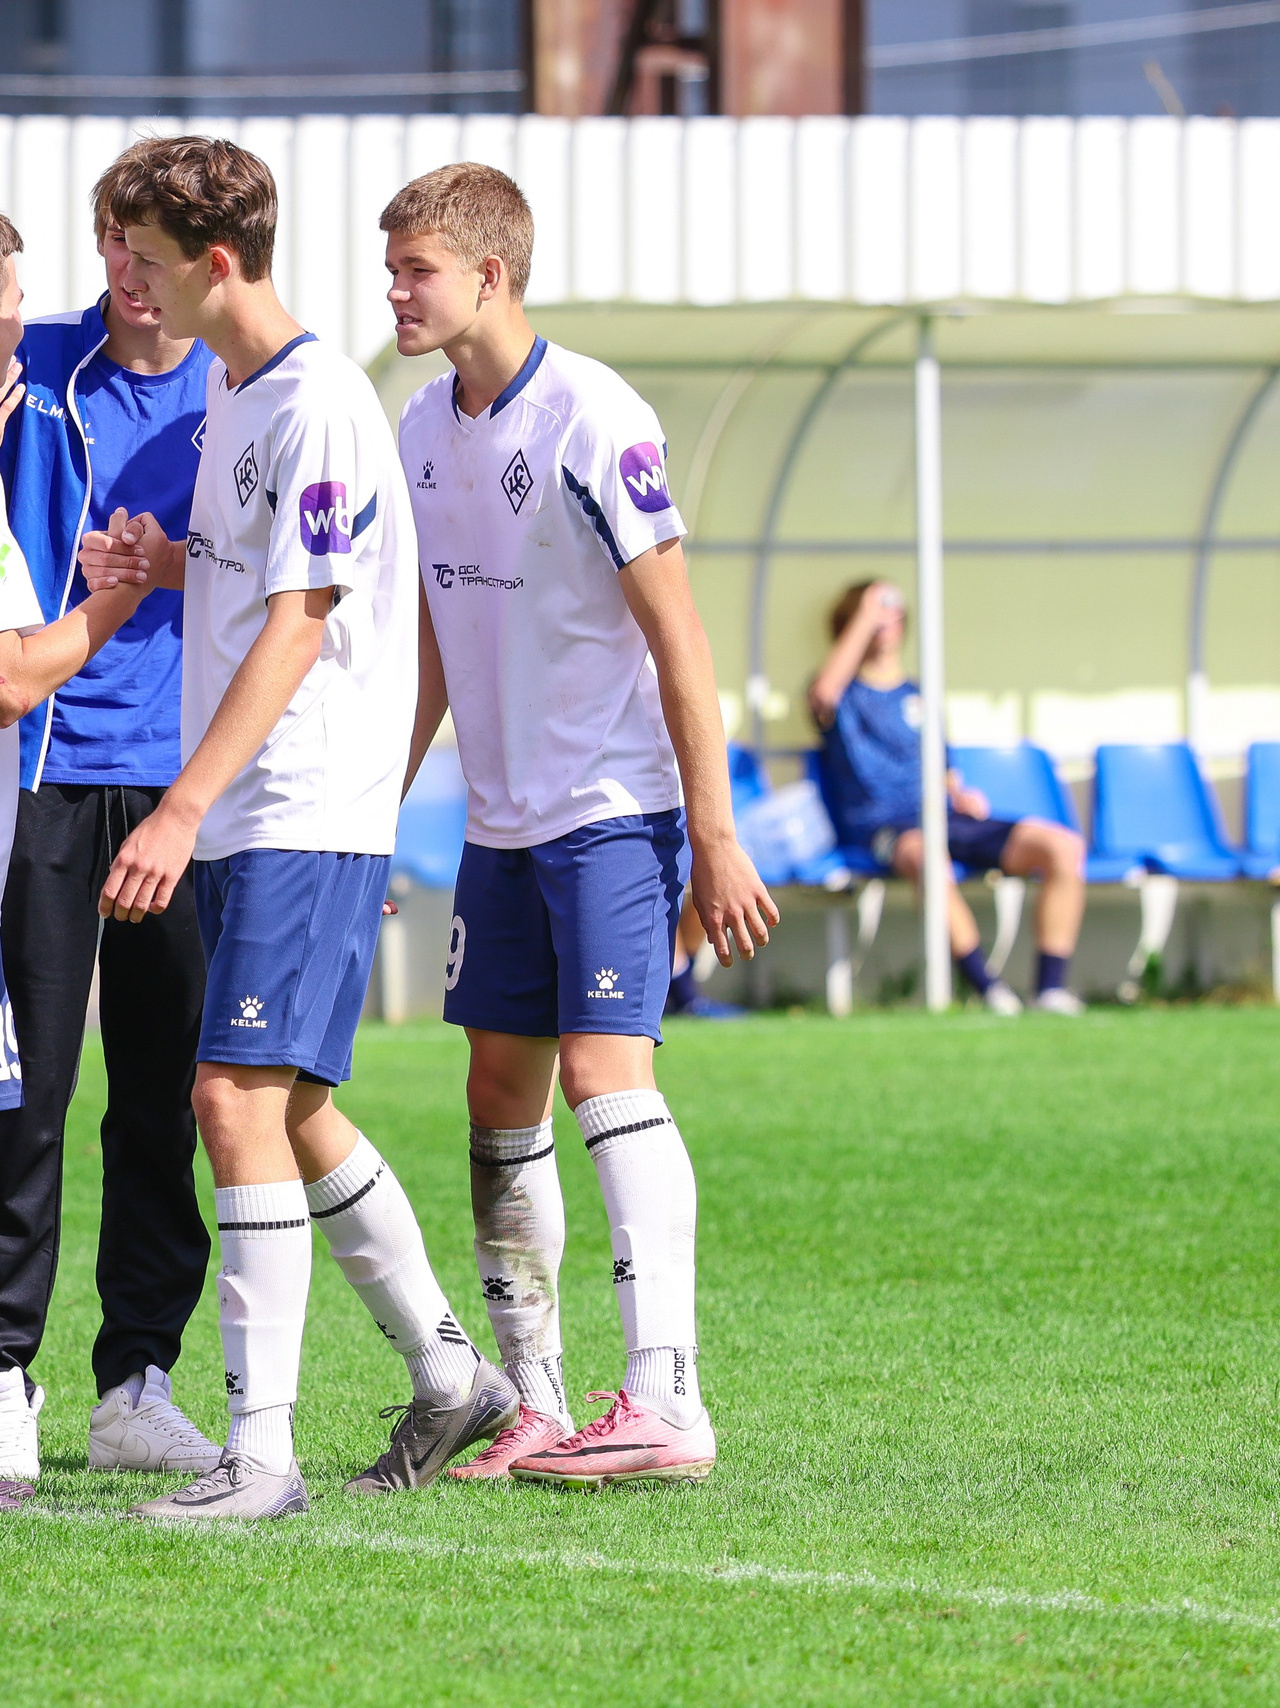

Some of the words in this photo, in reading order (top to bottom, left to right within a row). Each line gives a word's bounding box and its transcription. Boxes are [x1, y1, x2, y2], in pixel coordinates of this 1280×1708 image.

[416, 481, 437, 490] KELME
[303, 496, 350, 536] wb
[458, 564, 481, 576] ДСК
[586, 990, 625, 1000] KELME
[230, 1017, 268, 1029] KELME
